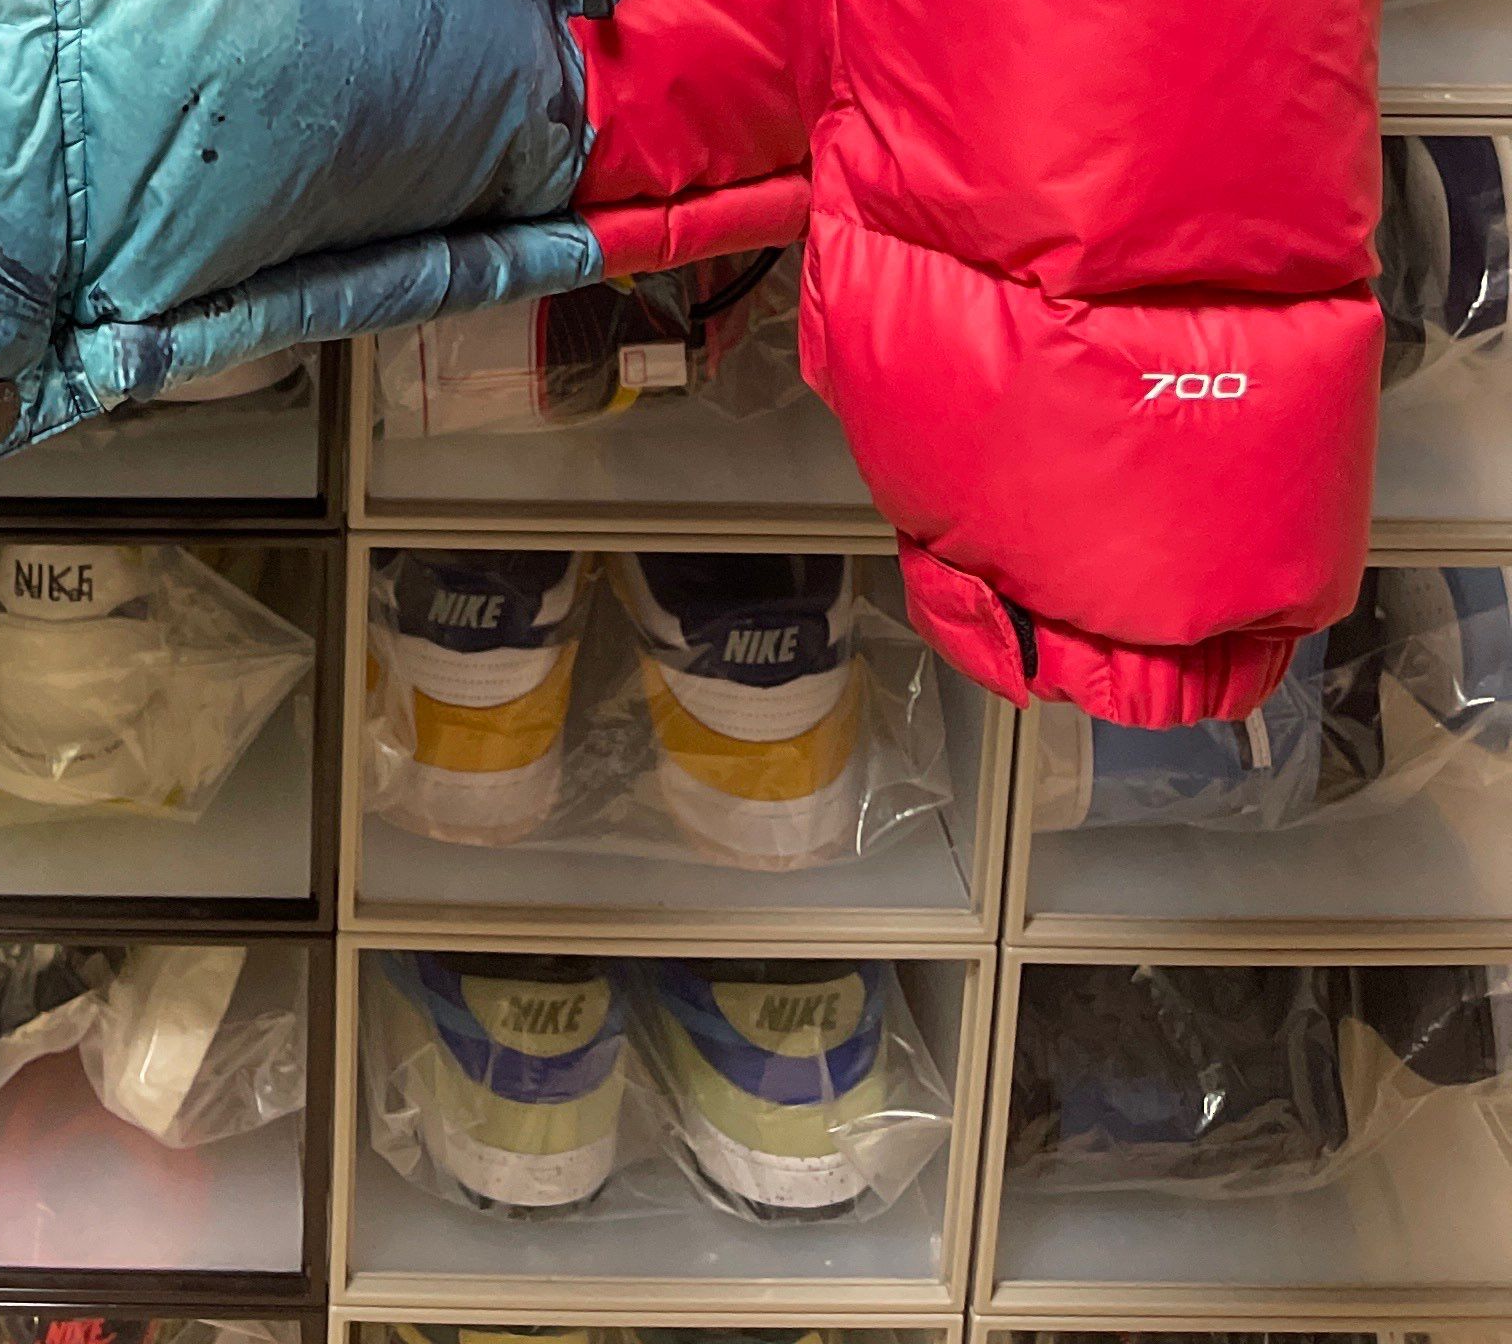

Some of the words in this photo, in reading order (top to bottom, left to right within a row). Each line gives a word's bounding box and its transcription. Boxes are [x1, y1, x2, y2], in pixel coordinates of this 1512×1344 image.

[1141, 373, 1247, 400] 700
[428, 590, 505, 628] NIKE
[724, 626, 799, 664] NIKE
[501, 994, 585, 1033] NIKE
[755, 992, 840, 1031] NIKE
